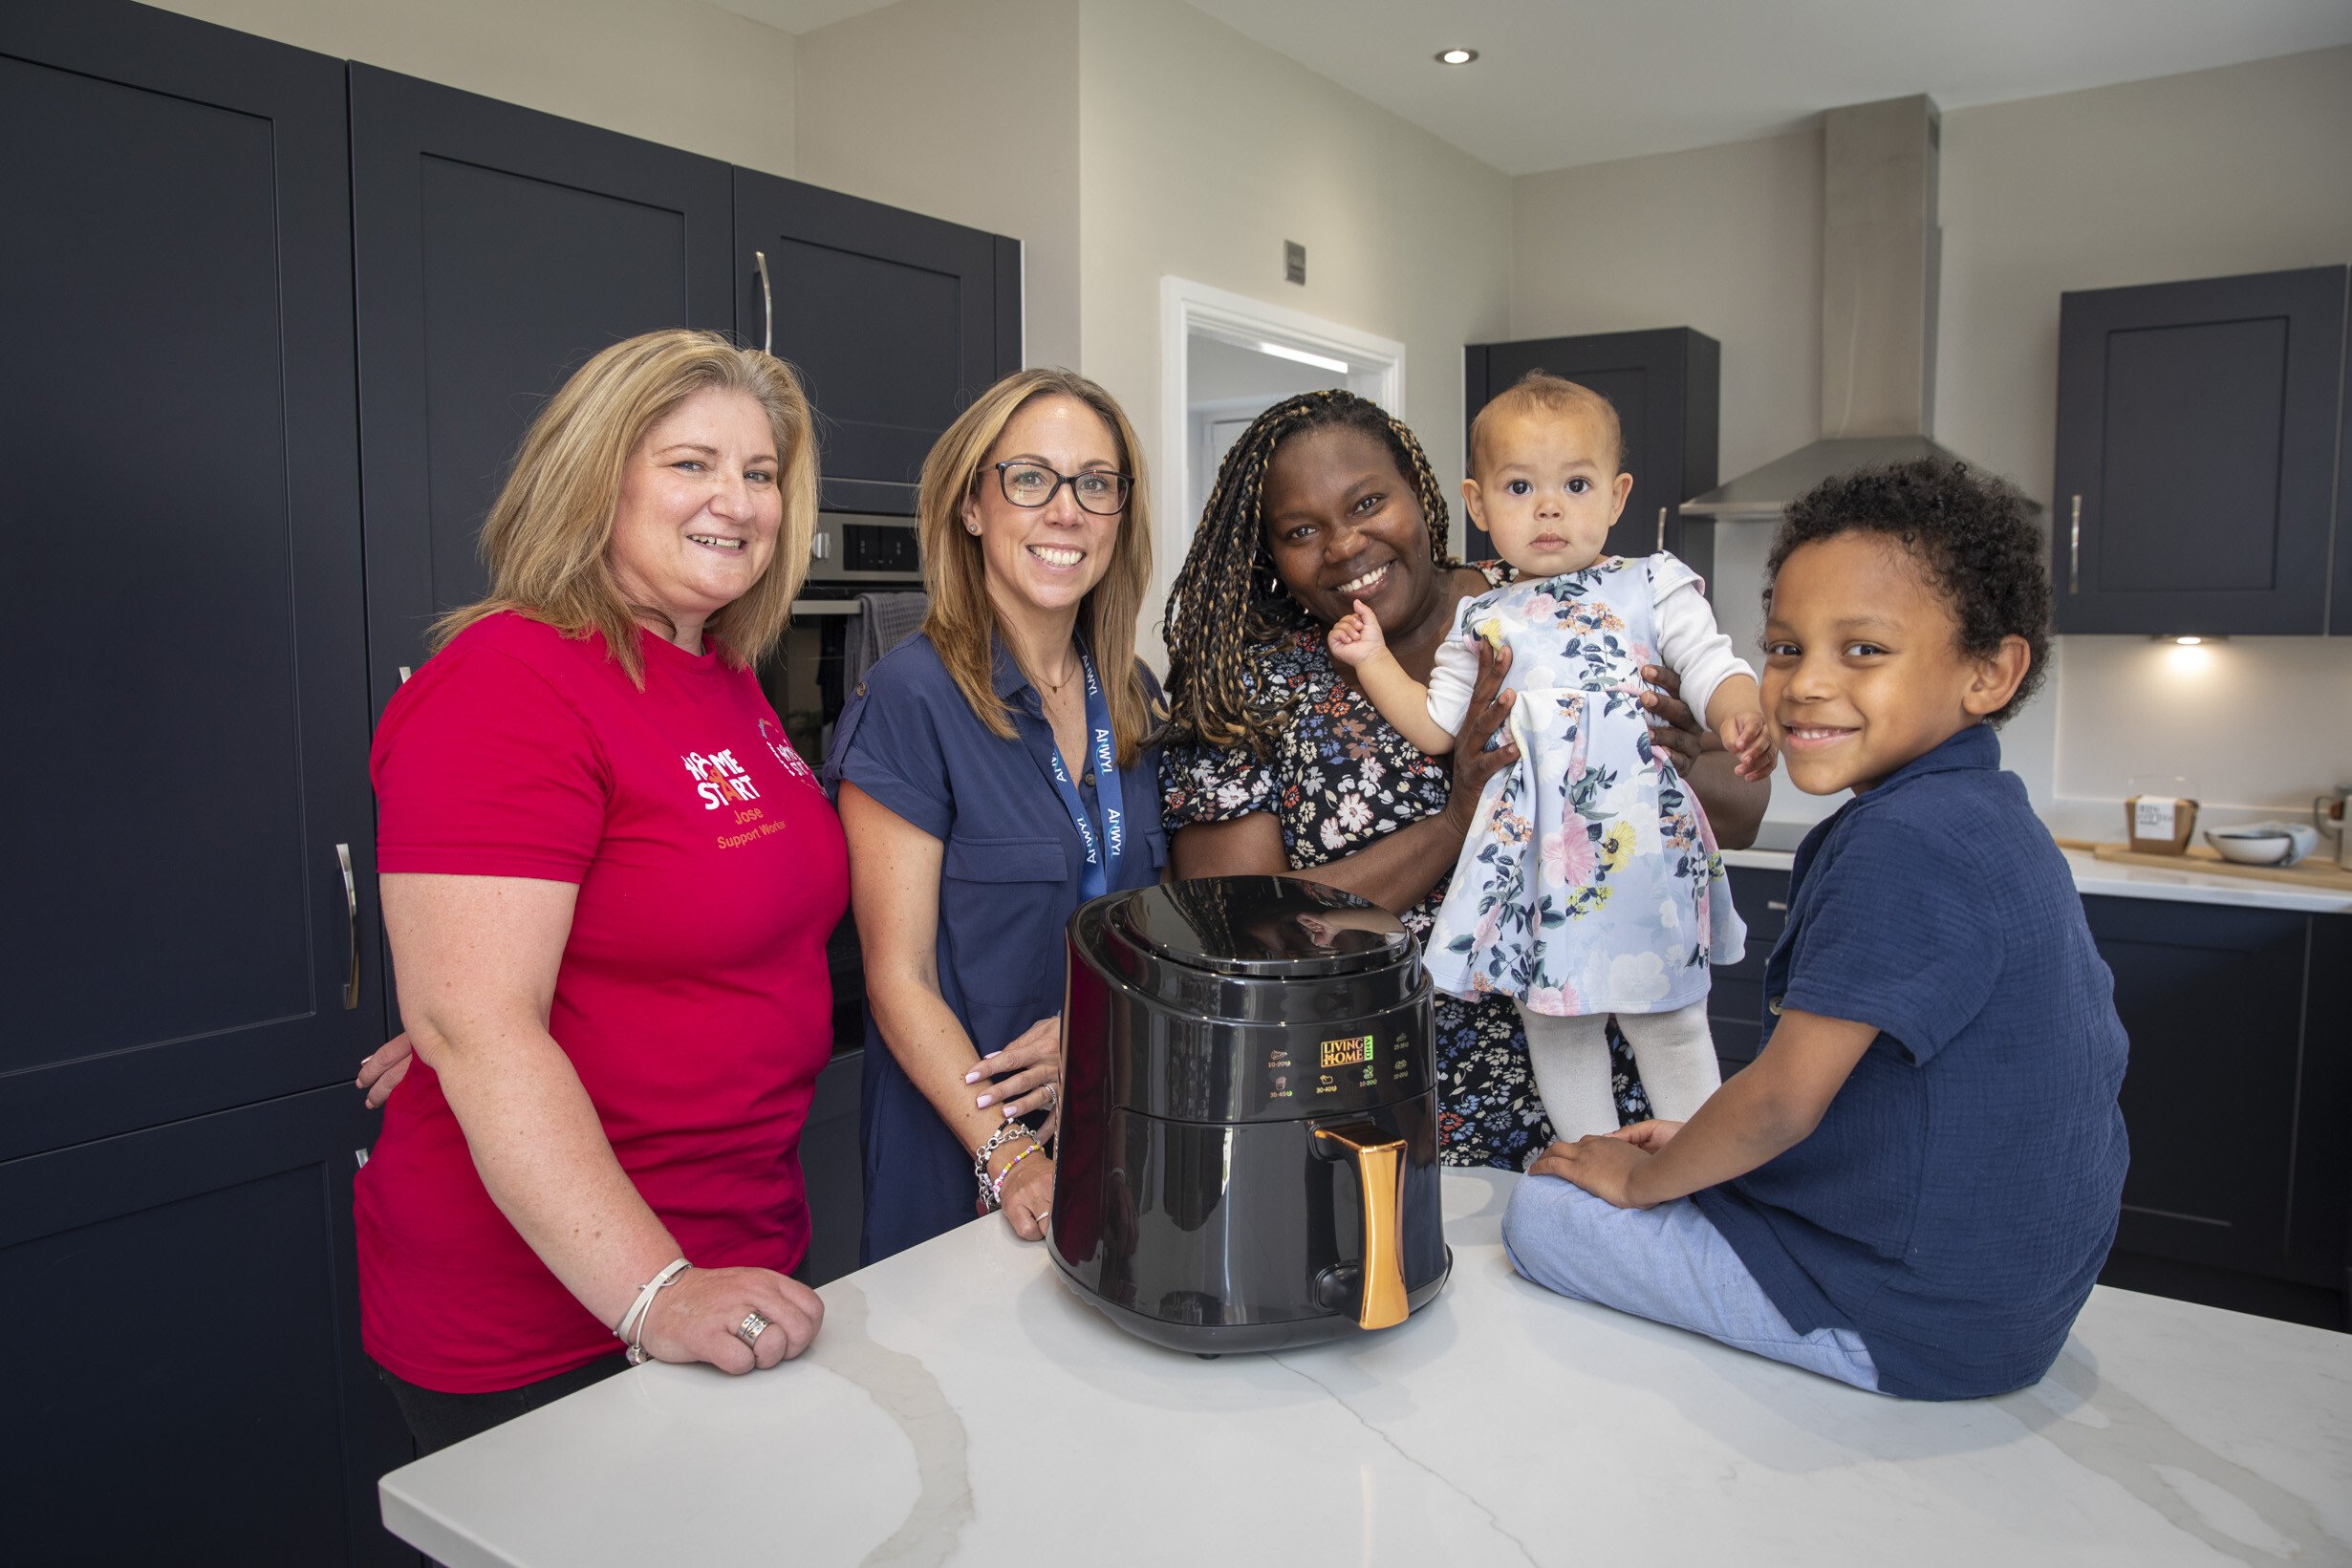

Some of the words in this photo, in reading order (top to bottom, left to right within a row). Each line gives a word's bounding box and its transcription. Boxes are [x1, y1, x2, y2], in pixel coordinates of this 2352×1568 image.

[680, 748, 744, 781] HOME
[1095, 728, 1112, 778] ANWYL
[697, 775, 761, 810] START
[734, 807, 764, 826] Jose
[717, 827, 761, 849] Support
[1076, 812, 1097, 864] ANWYL
[1107, 807, 1122, 860] ANWYL
[1323, 1048, 1364, 1065] HOME
[1324, 1038, 1364, 1054] LIVING
